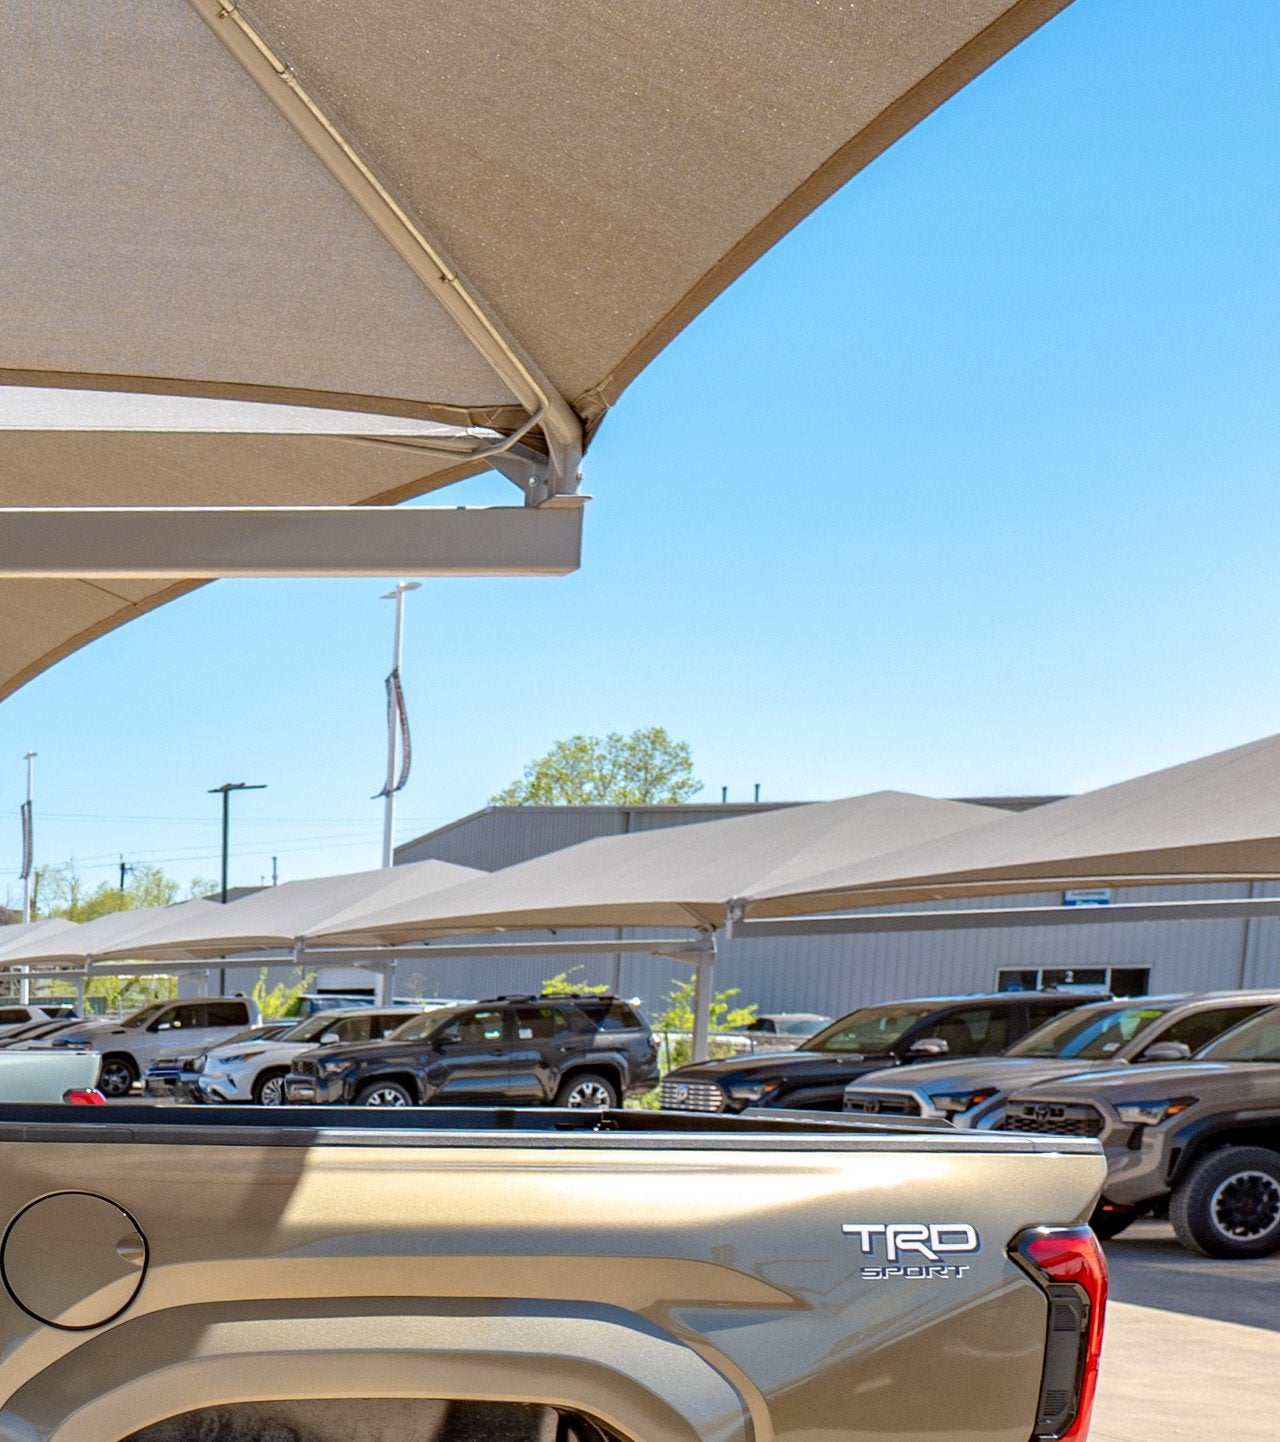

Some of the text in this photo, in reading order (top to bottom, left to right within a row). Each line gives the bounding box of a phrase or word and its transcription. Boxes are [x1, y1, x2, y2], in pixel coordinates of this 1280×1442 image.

[1064, 970, 1074, 983] 2
[841, 1223, 980, 1262] TRD
[860, 1265, 970, 1280] SPORT
